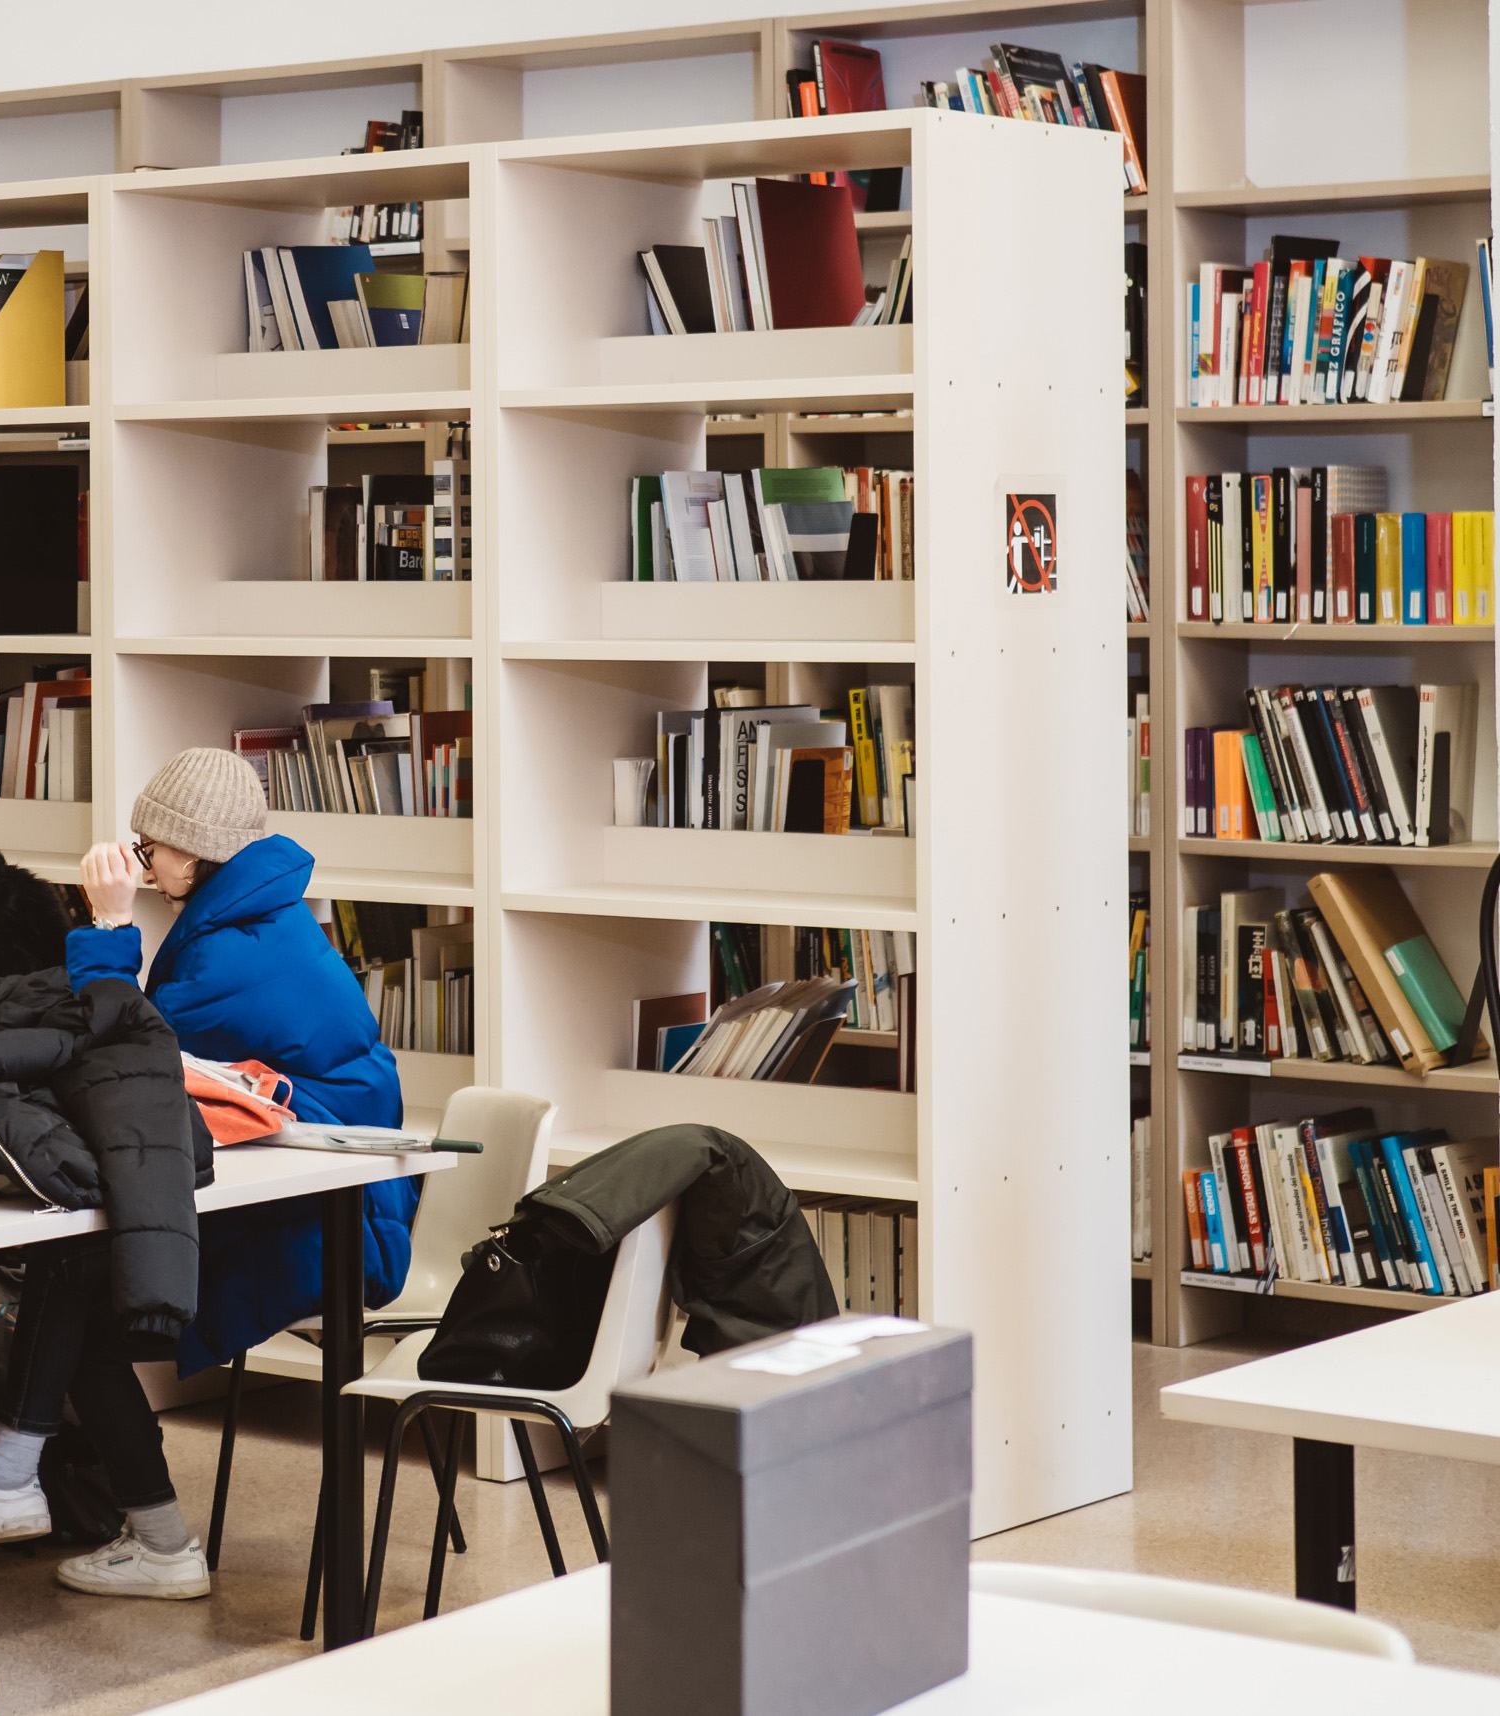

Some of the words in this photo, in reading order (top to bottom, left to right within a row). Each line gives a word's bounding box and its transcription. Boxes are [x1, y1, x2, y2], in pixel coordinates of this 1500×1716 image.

[1237, 1149, 1252, 1190] DESIGN
[1287, 1154, 1296, 1177] mundo
[1304, 1128, 1319, 1173] Graphic
[1313, 1177, 1327, 1217] Design
[1244, 1192, 1257, 1224] IDEAS
[1441, 1168, 1452, 1191] SMILE
[1451, 1204, 1460, 1217] THE
[1456, 1219, 1466, 1239] MIND
